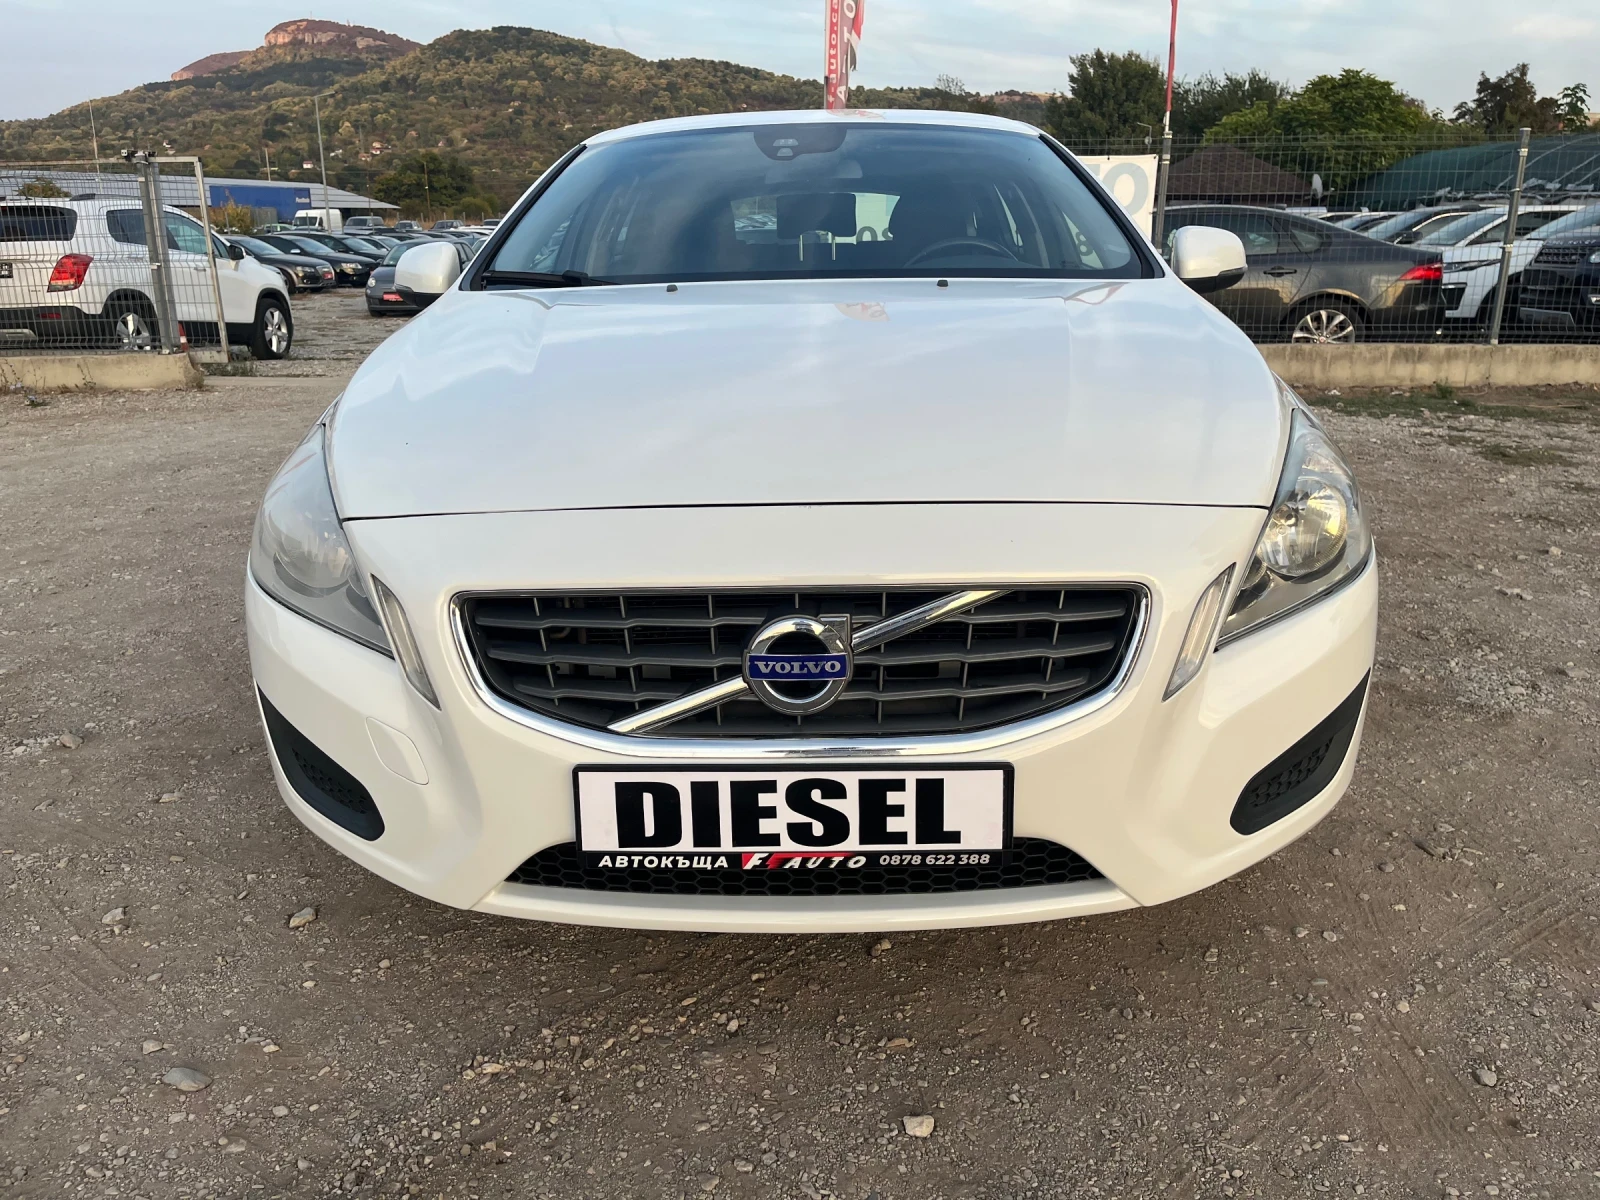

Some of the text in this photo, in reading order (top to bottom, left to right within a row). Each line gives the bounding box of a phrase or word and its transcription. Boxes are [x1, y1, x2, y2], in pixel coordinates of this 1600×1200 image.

[754, 660, 842, 674] VOLVO
[614, 777, 962, 849] DIESEL
[598, 855, 729, 870] АВТОКЪЩА
[782, 855, 867, 869] AUTO
[879, 854, 922, 865] 0878
[925, 854, 956, 865] 622
[958, 853, 991, 865] 388
